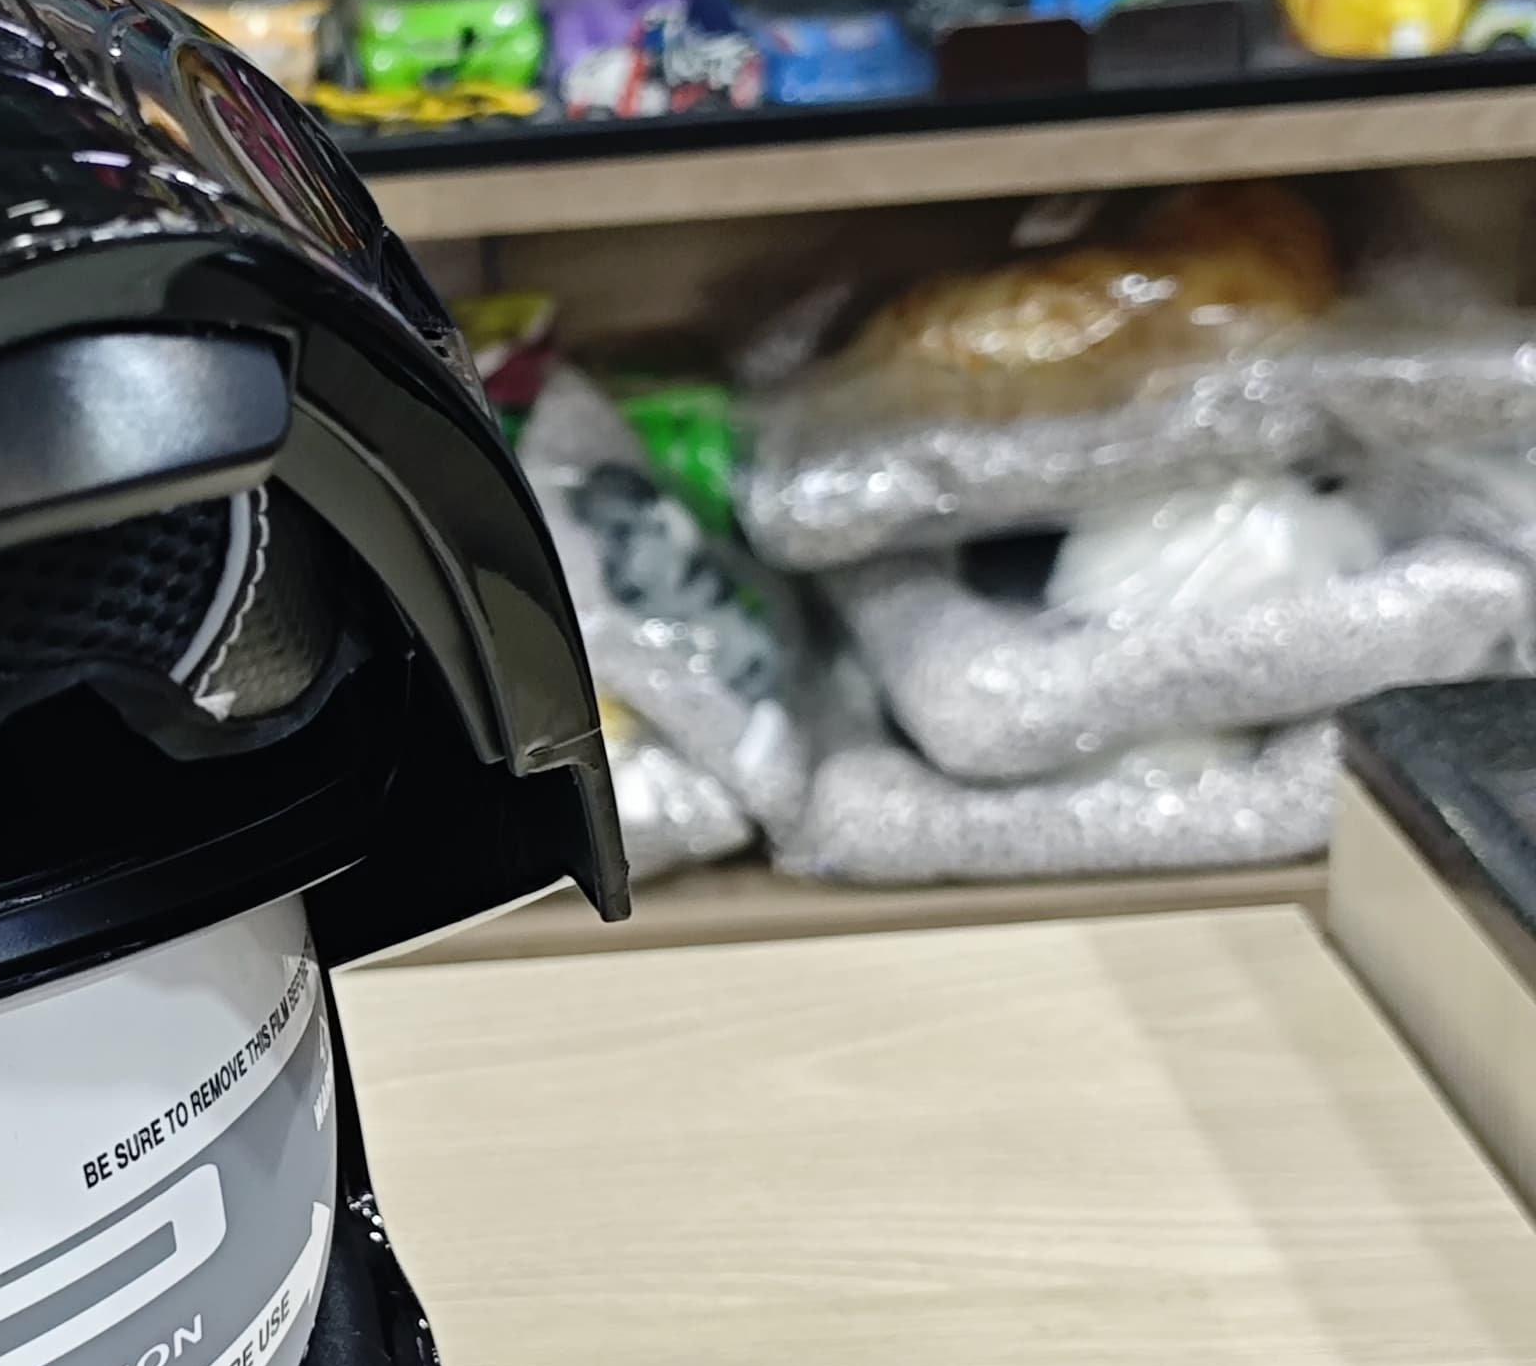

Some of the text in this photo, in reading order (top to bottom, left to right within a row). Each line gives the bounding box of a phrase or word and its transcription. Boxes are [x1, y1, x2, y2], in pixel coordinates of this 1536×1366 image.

[82, 1152, 112, 1189] BE
[114, 1117, 165, 1170] SURE
[164, 1101, 189, 1135] TO
[189, 1051, 248, 1117] REMOVE
[245, 1022, 272, 1066] THIS
[269, 995, 290, 1040] FILM
[258, 1288, 292, 1354] USE
